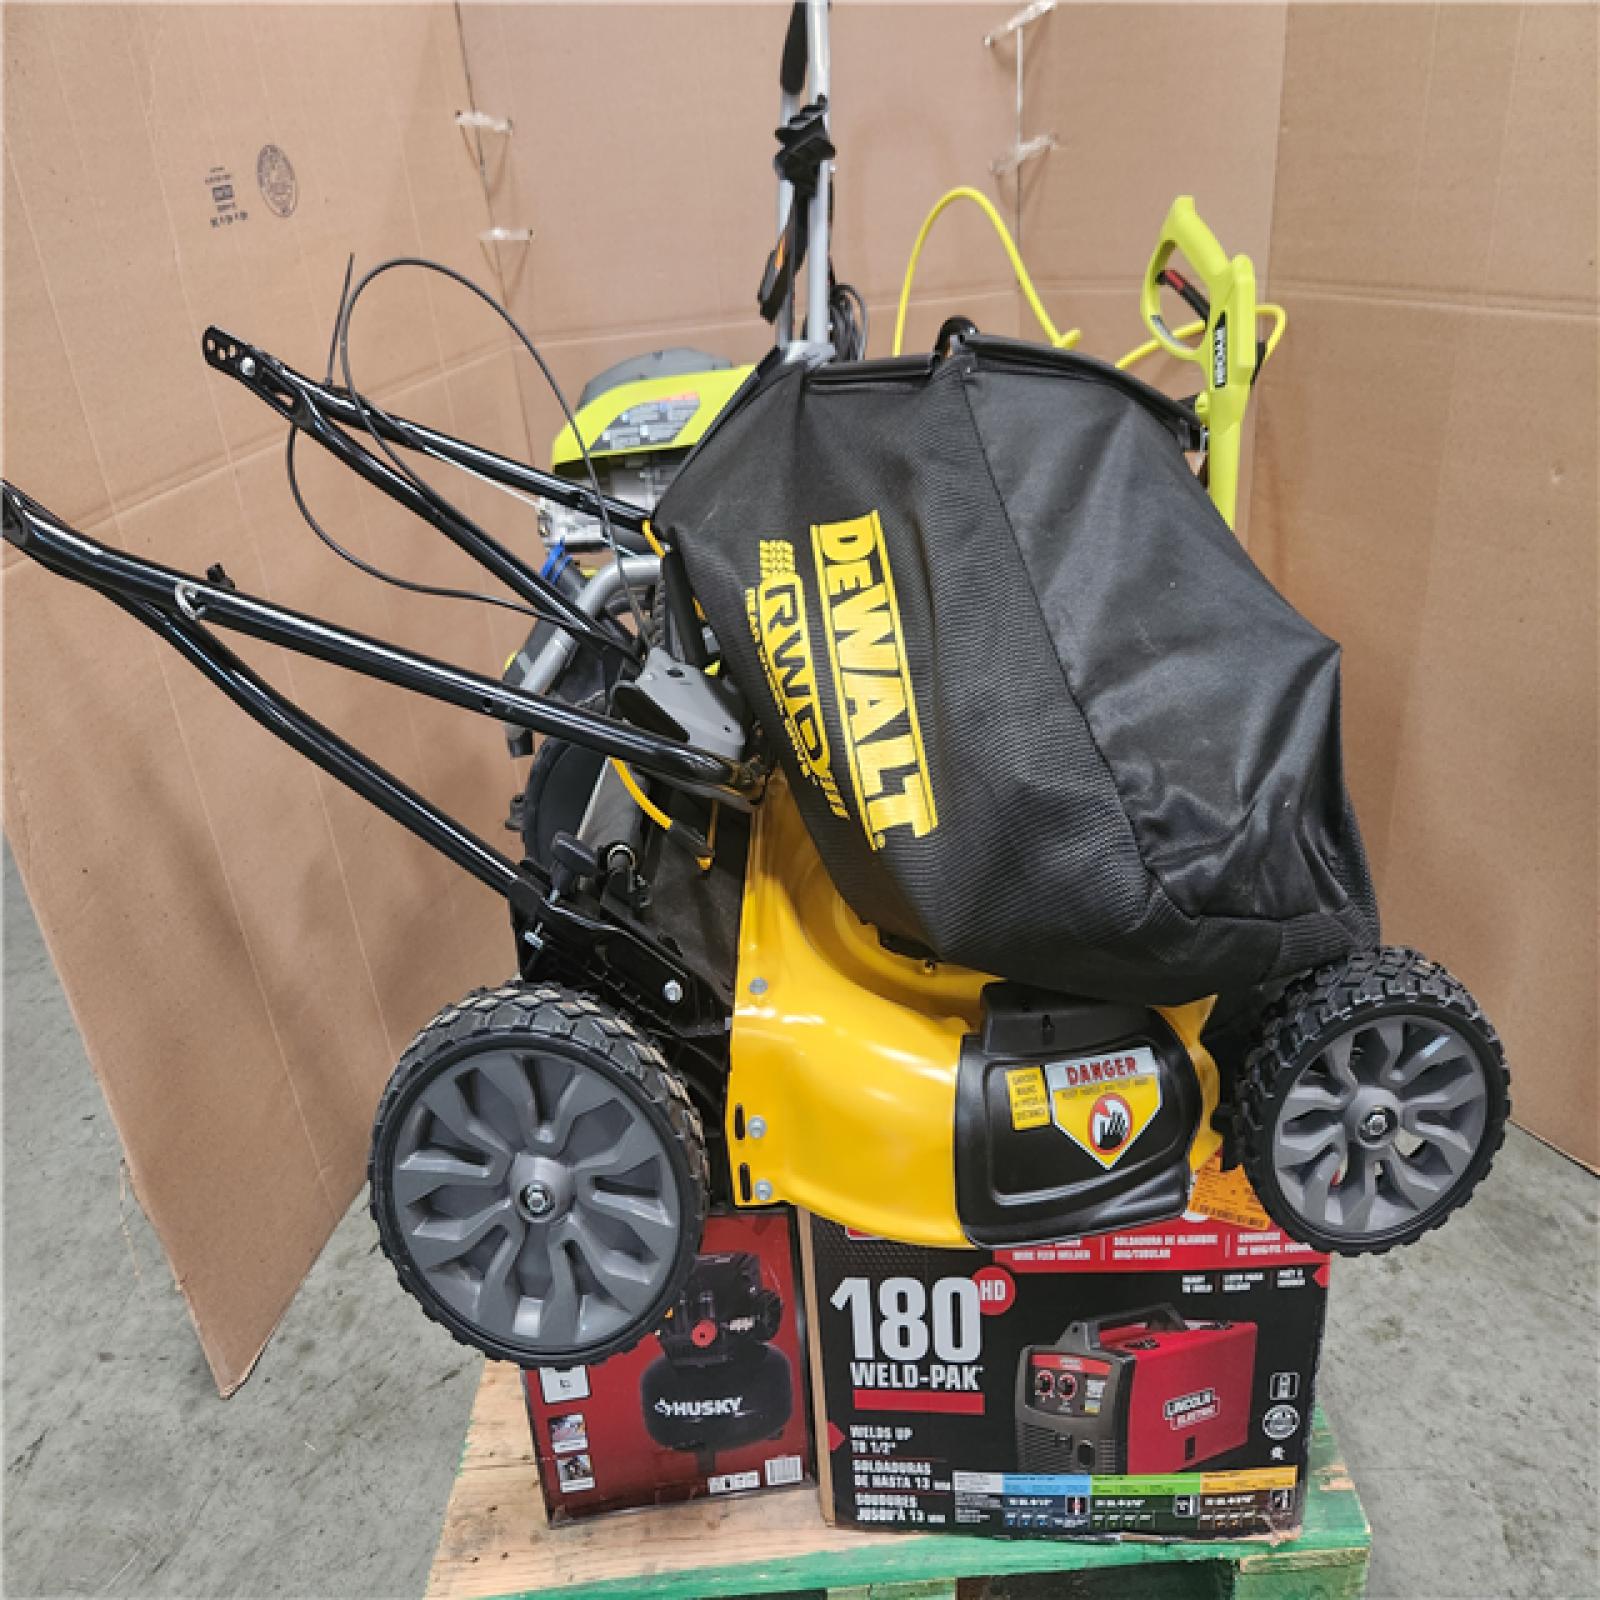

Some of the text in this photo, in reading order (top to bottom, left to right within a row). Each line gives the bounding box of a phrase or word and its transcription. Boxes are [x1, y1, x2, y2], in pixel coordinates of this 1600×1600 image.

[762, 582, 822, 762] RWD
[1065, 1056, 1137, 1086] DANGER
[829, 1276, 1006, 1362] 180 HD
[850, 1362, 981, 1391] WELD-PAK
[674, 1397, 743, 1417] HUSKY
[1166, 1389, 1212, 1416] LINCOLN
[850, 1425, 913, 1441] WELDS UP
[852, 1460, 931, 1476] SOLDADURAS
[854, 1475, 868, 1487] DE
[871, 1475, 911, 1489] HASTA
